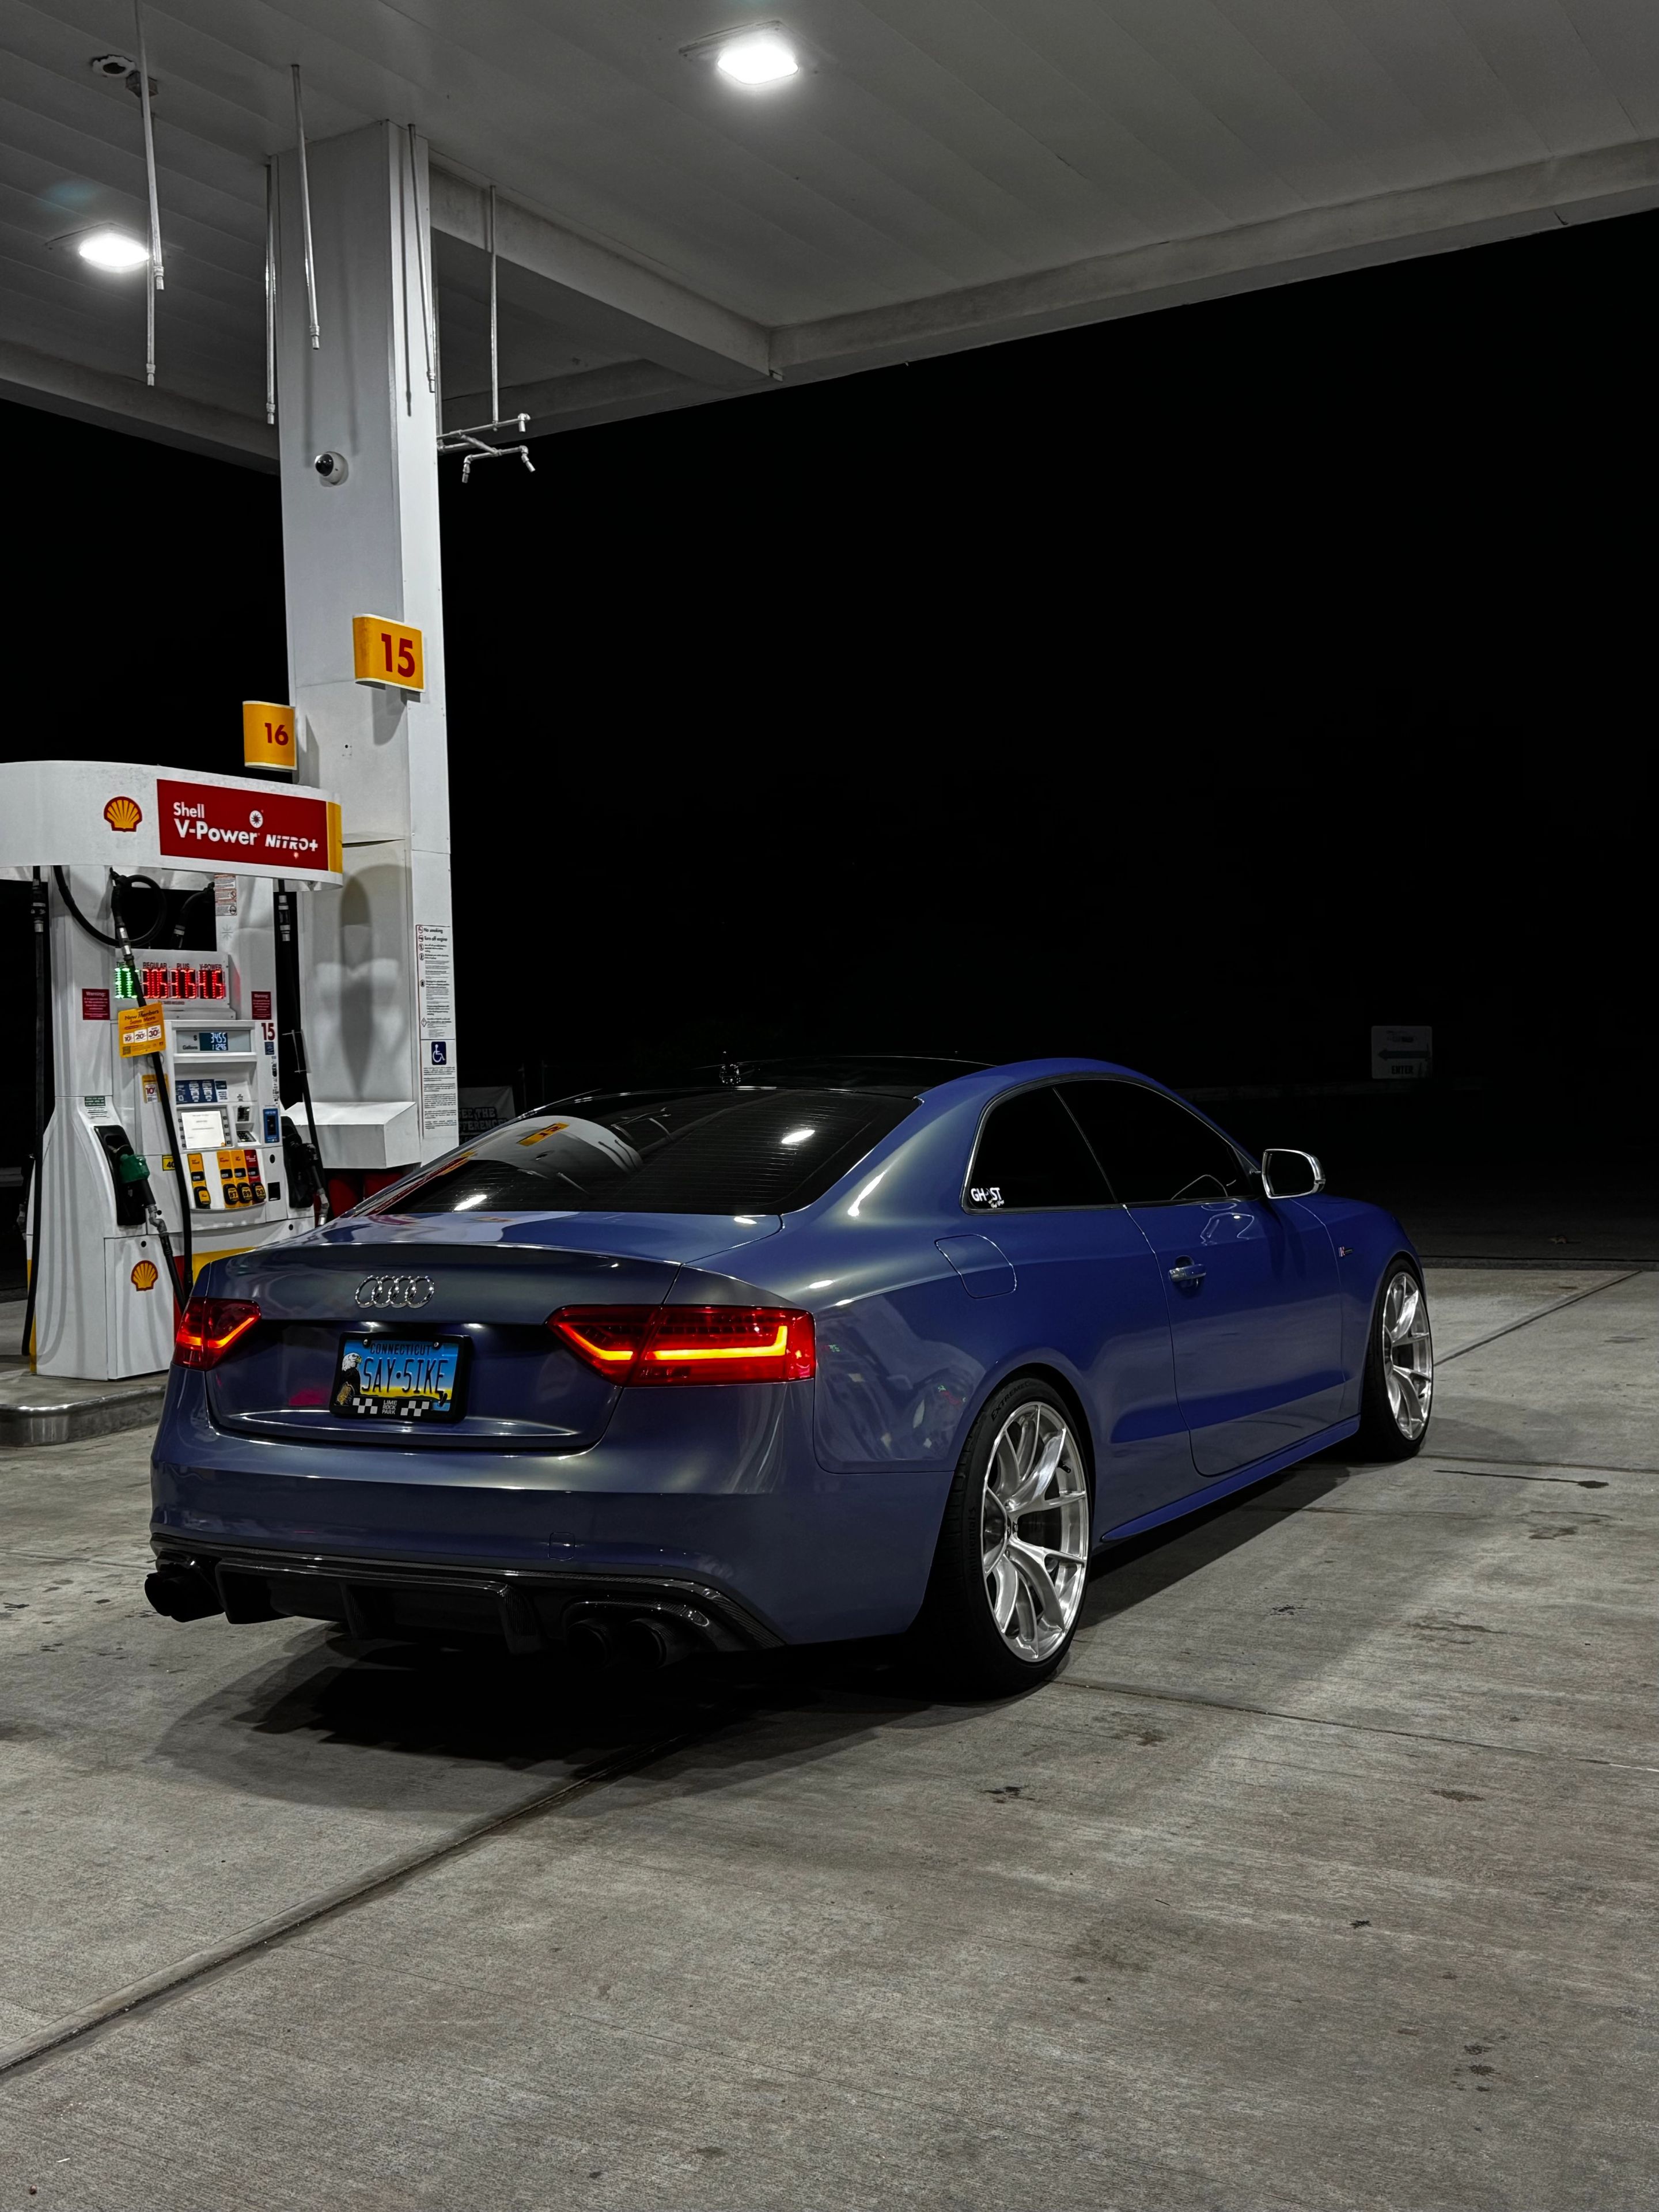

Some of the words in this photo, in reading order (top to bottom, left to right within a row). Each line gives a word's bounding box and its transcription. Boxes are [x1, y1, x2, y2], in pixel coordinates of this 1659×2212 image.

[381, 632, 415, 678] 15
[264, 722, 289, 746] 16
[173, 801, 204, 819] Shell
[174, 818, 257, 846] V-Power
[261, 1022, 275, 1041] 15
[475, 1108, 495, 1118] THE
[370, 1343, 432, 1355] CONNECTICUT
